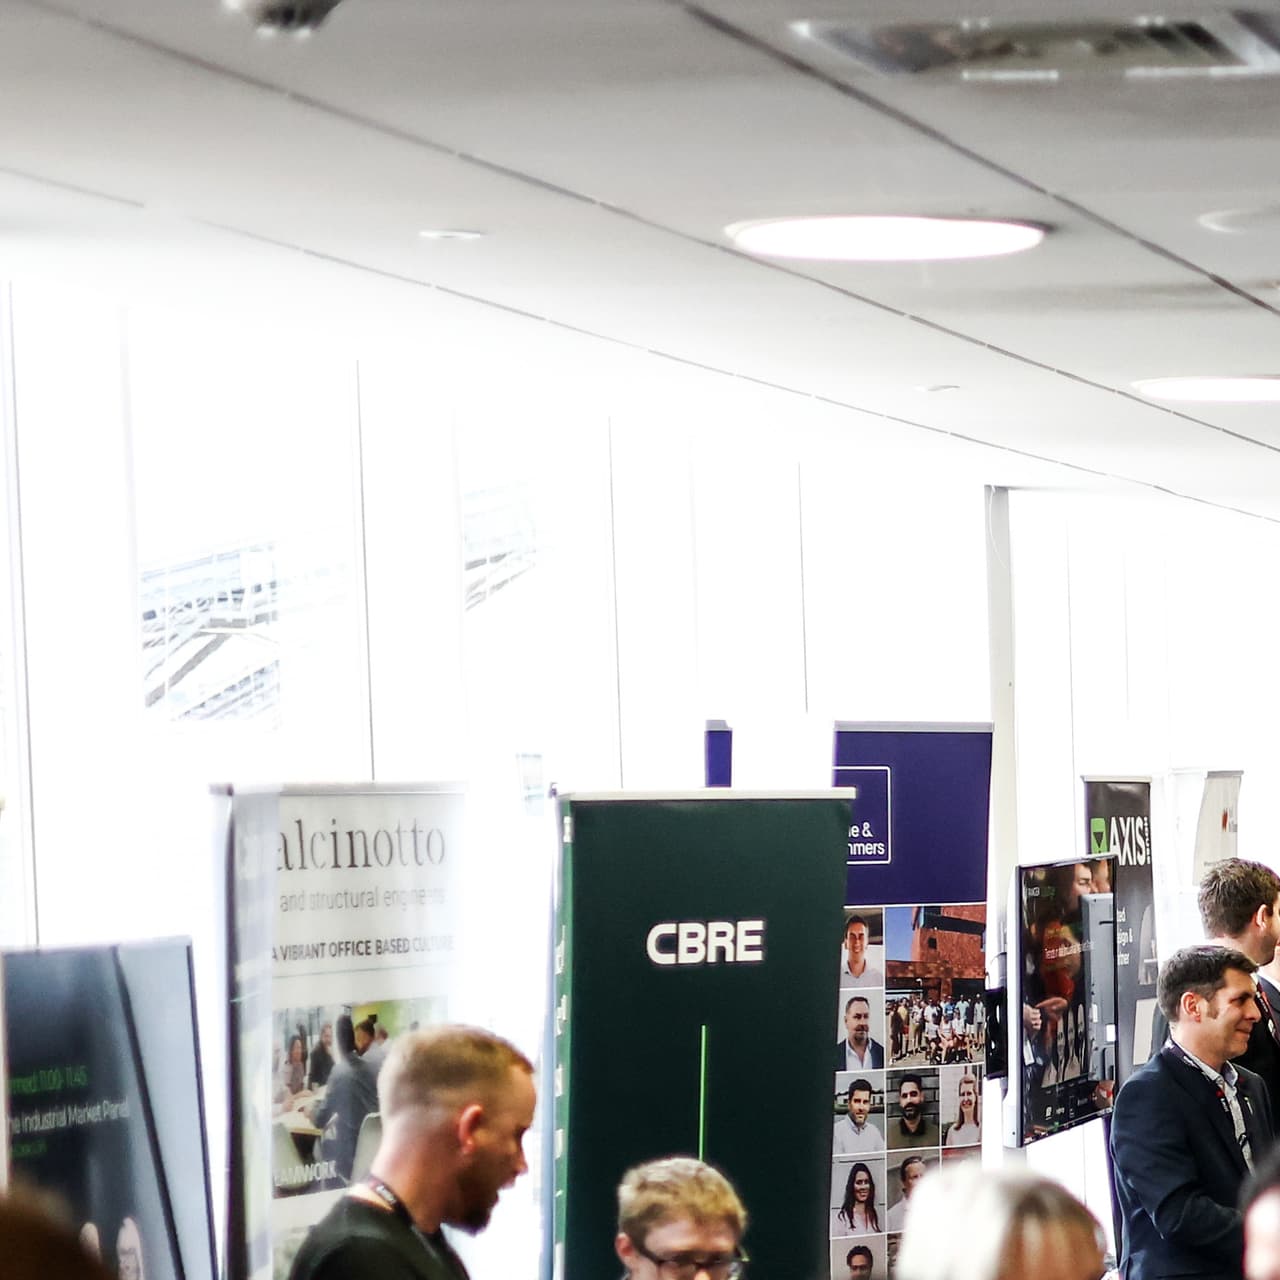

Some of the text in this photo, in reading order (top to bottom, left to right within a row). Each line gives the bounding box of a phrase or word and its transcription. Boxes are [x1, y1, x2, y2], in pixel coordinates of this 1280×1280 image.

[848, 821, 873, 837] e &
[1109, 816, 1146, 866] AXIS
[279, 890, 305, 912] and
[309, 884, 380, 910] structural
[279, 942, 327, 961] VIBRANT
[328, 939, 372, 958] OFFICE
[375, 937, 410, 956] BASED
[646, 920, 764, 965] CBRE
